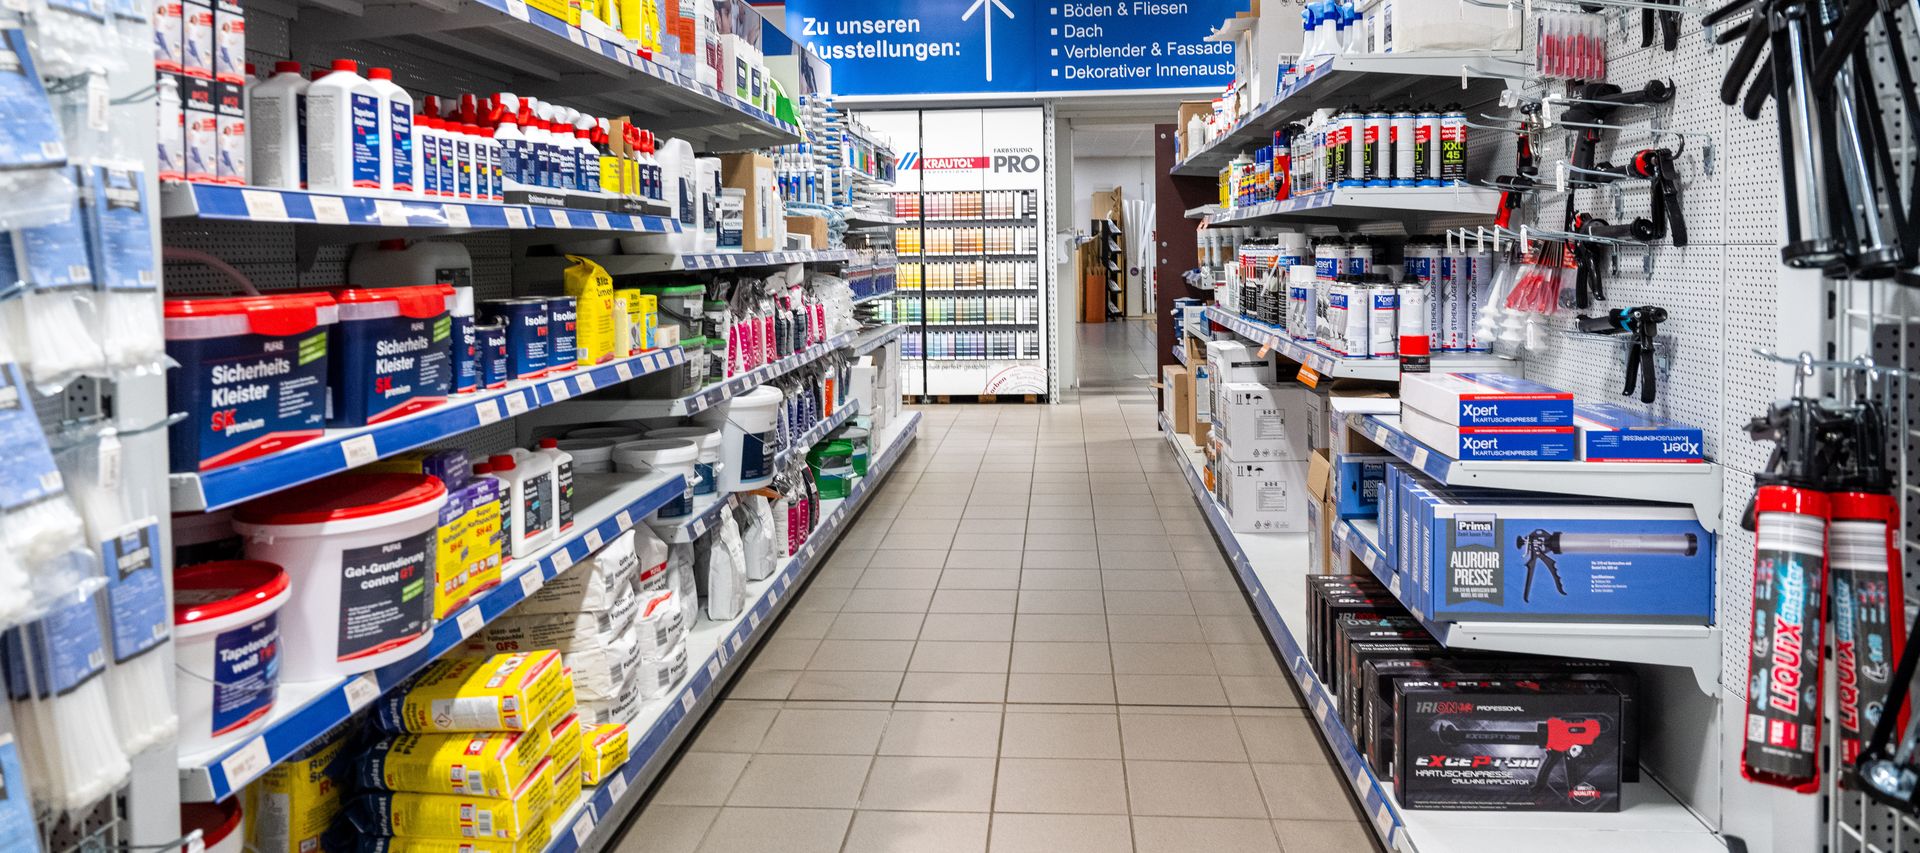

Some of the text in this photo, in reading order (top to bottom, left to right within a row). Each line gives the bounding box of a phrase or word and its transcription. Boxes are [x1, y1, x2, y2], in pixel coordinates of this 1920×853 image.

[1064, 1, 1188, 17] Böden & Fliesen
[803, 18, 920, 35] Zu unseren
[1064, 24, 1104, 38] Dach
[807, 40, 961, 61] Ausstellungen:
[1064, 41, 1233, 59] Verblender & Fassade
[1065, 62, 1235, 79] Dekorativer Innenausb
[1443, 142, 1464, 151] XXL
[1446, 151, 1461, 160] 45
[993, 155, 1040, 173] PRO
[1377, 296, 1397, 306] Xper
[376, 336, 428, 356] Sicherheits
[211, 358, 290, 385] Sicherheits
[375, 357, 414, 375] Kleister
[211, 384, 269, 407] Kleister
[211, 409, 237, 432] SK
[1463, 404, 1498, 423] Xpert
[226, 418, 264, 437] premium
[1463, 438, 1498, 456] Xpert
[1663, 436, 1699, 455] Xpert
[1458, 521, 1491, 530] Prima
[344, 552, 425, 579] Gel-Grundierung
[1450, 551, 1500, 568] ALUROHR
[360, 571, 400, 590] control
[1454, 569, 1494, 586] PRESSE
[496, 641, 519, 651] GFS
[1573, 790, 1595, 798] QUALITY
